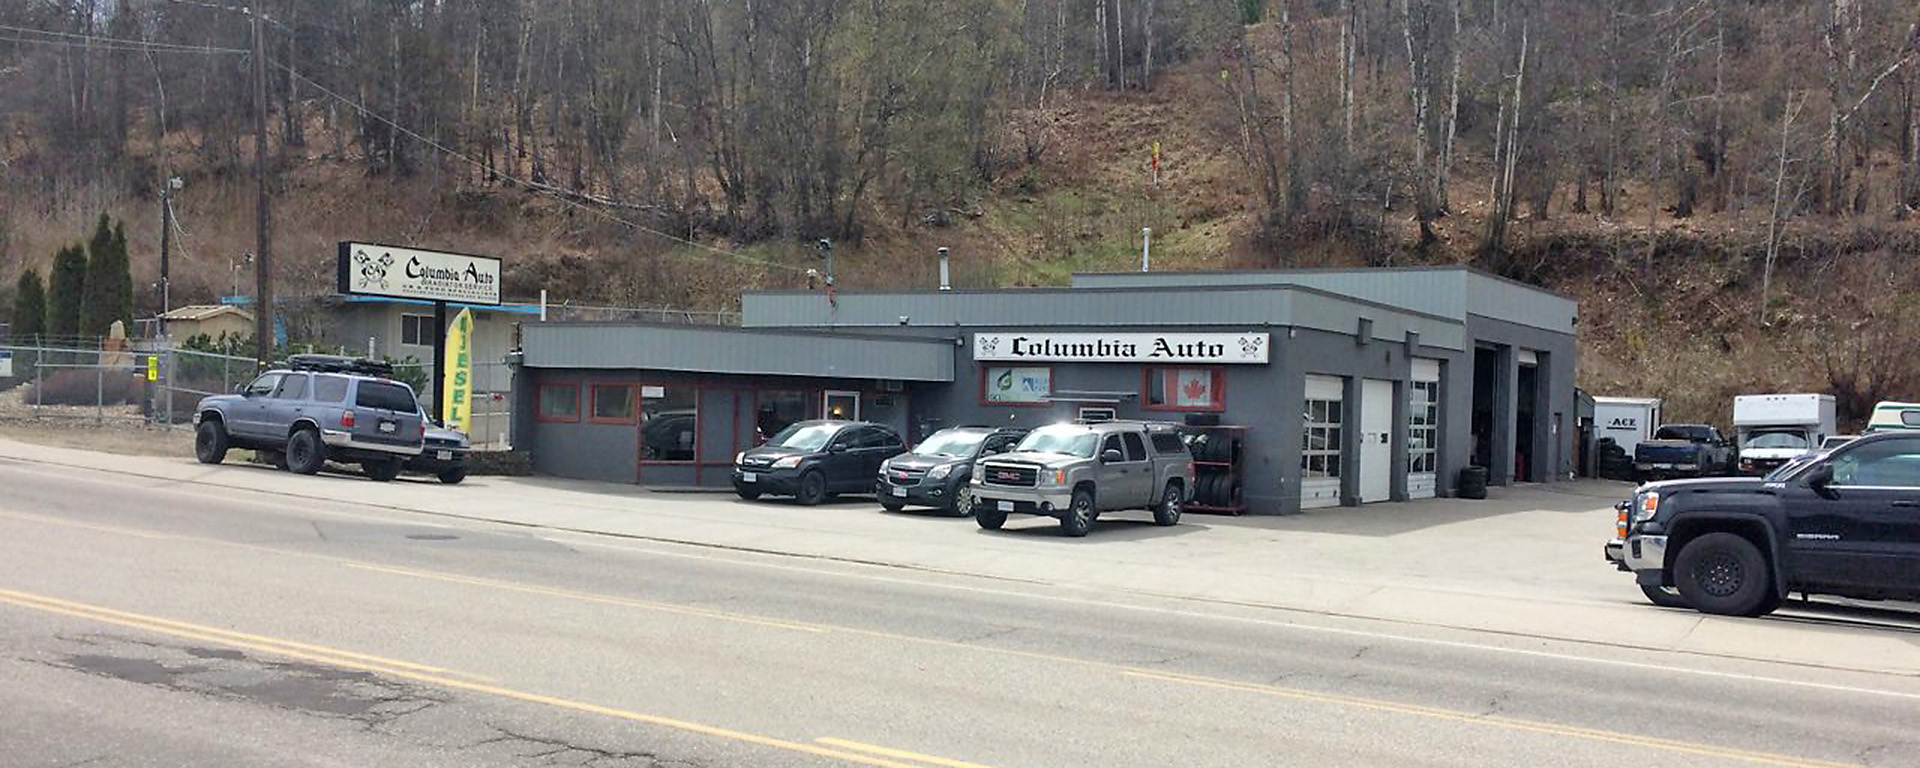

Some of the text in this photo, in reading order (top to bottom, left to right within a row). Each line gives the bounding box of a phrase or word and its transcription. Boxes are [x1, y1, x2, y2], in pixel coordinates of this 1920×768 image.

[406, 255, 494, 284] Columbia Auto
[1011, 336, 1224, 358] Columbia Auto
